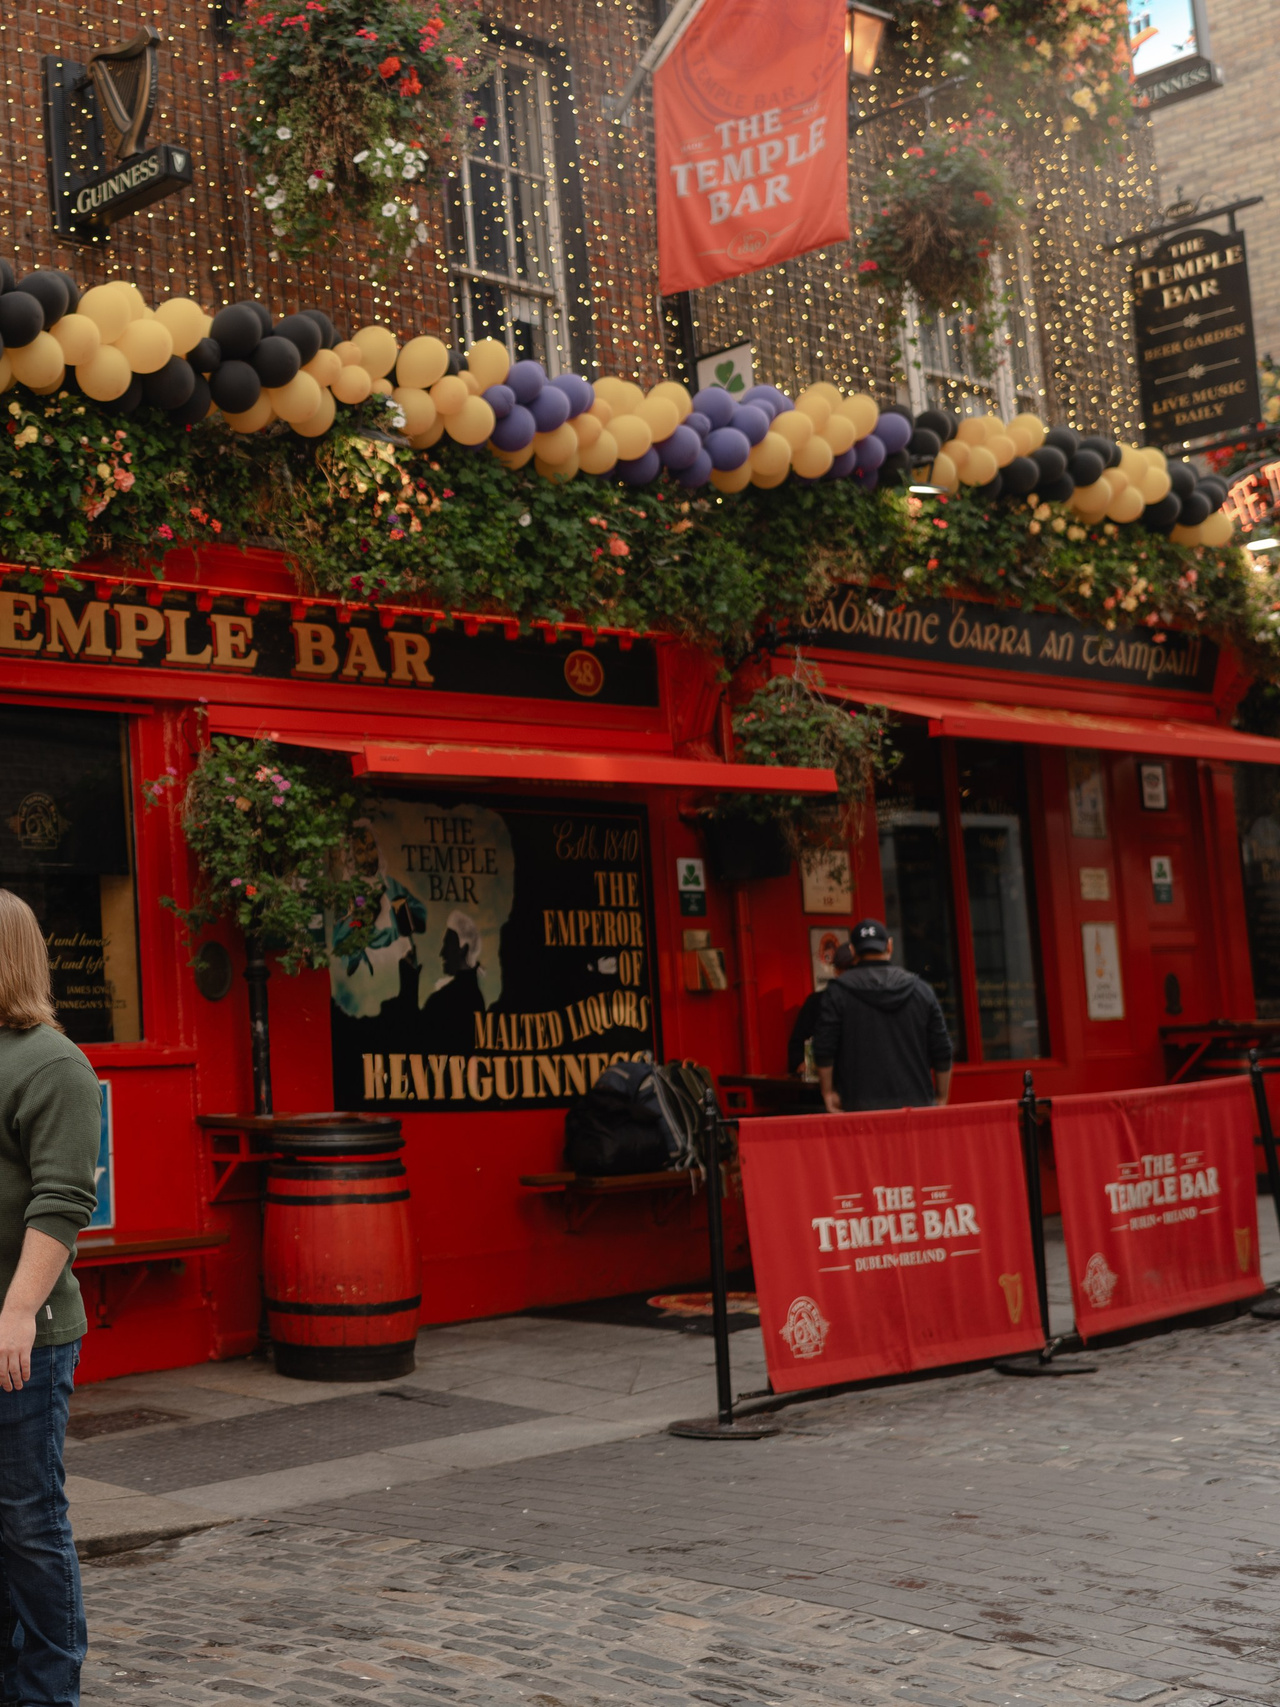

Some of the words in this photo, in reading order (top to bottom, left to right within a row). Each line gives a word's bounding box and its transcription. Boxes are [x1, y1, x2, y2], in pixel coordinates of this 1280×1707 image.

[1136, 65, 1210, 103] UINNESS
[714, 107, 784, 150] THE
[670, 116, 827, 198] TEMPLE
[76, 155, 160, 213] GUINNESS
[707, 174, 792, 225] BAR
[1168, 236, 1206, 259] THE
[1134, 244, 1244, 291] TEMPLE
[1161, 278, 1221, 310] BAR
[1144, 341, 1183, 362] BEER
[1183, 322, 1246, 351] GARDEN
[1152, 393, 1191, 416] LIVE
[1191, 379, 1247, 405] MUSIC
[1175, 401, 1226, 426] DAILY
[290, 620, 435, 688] BAR
[424, 816, 475, 846] THE
[603, 826, 639, 862] 1840
[401, 844, 499, 875] TEMPLE
[428, 873, 479, 905] BAR
[594, 871, 640, 907] THE
[542, 909, 644, 948] EMPEROR
[619, 950, 643, 986] OF
[66, 985, 91, 995] JAMES
[474, 1010, 565, 1050] MALTED
[565, 989, 652, 1042] LIQUORS
[1141, 1153, 1177, 1178] THE
[872, 1186, 917, 1212] THE
[1104, 1176, 1179, 1214] TEMPLE
[1179, 1167, 1221, 1201] BAR
[811, 1212, 919, 1252] TEMPLE
[922, 1203, 981, 1240] BAR
